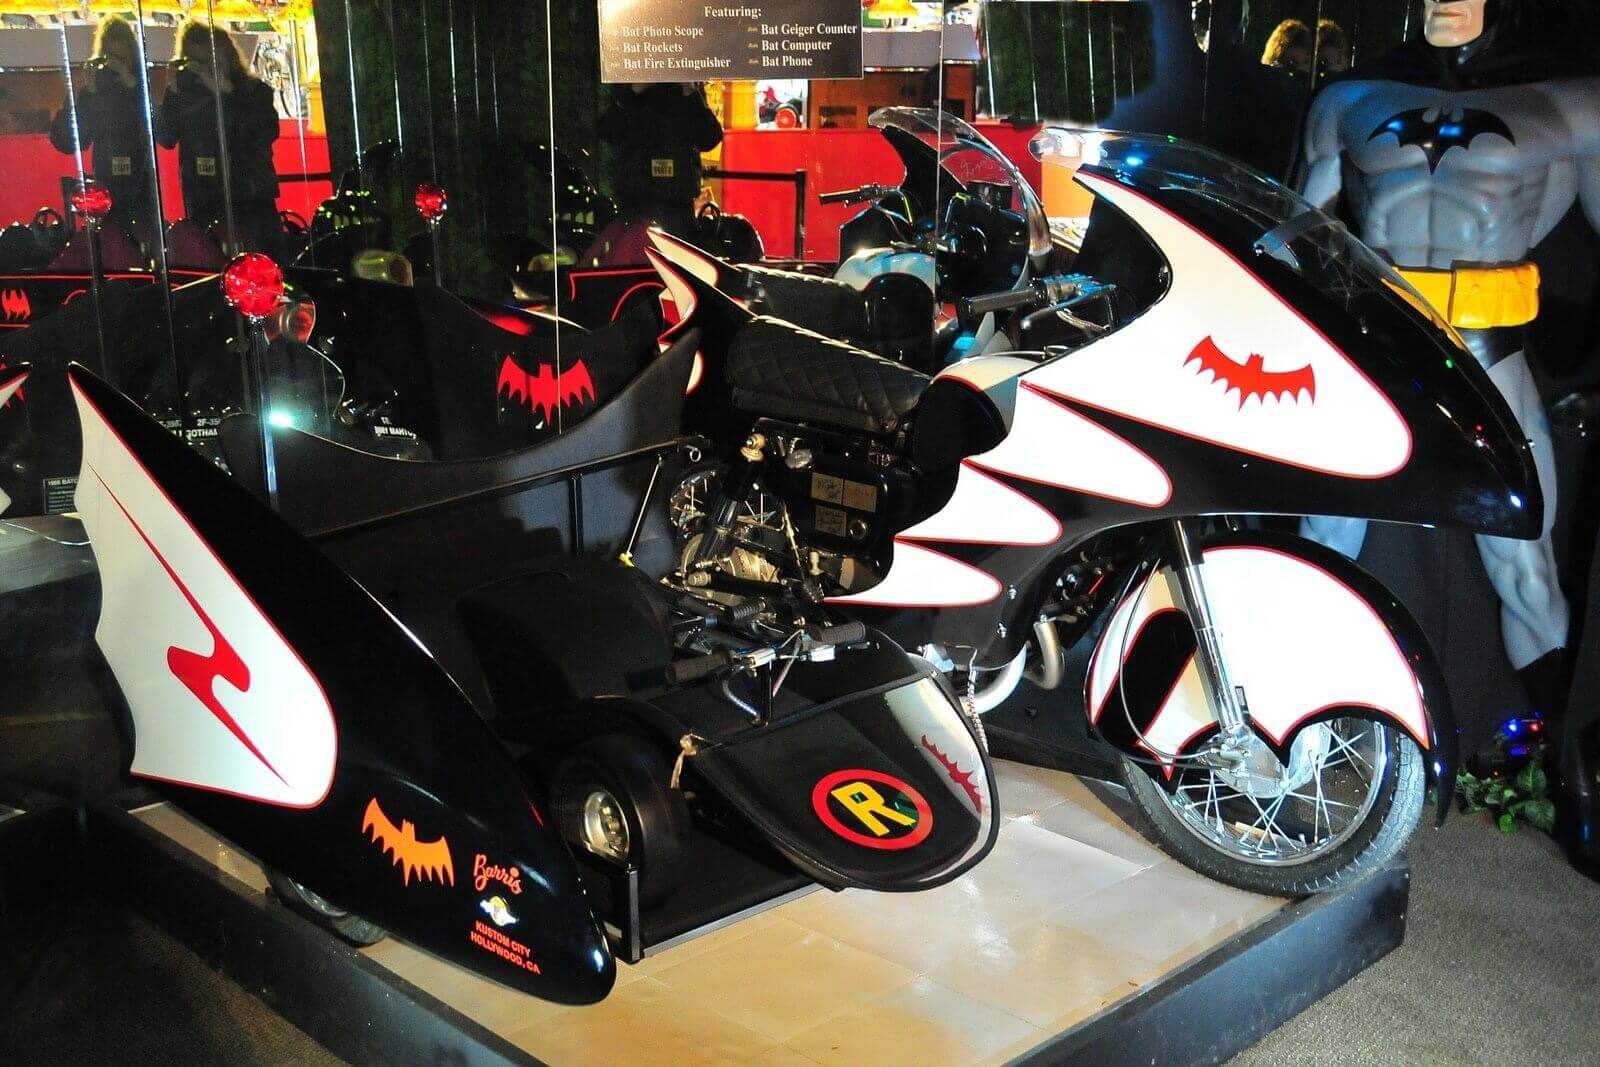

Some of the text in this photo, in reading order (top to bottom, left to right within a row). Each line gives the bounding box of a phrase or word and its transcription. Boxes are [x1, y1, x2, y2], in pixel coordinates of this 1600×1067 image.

[704, 5, 762, 19] Featuring:
[622, 25, 704, 39] Bat Photo Scope
[761, 23, 858, 37] Bat Geiger Counter
[623, 41, 683, 53] Bat Rockets
[761, 39, 832, 53] Bat Computer
[624, 56, 732, 70] Bat Fire Extinguisher
[762, 55, 813, 67] Bat Phone
[831, 781, 917, 837] R
[473, 853, 522, 895] Barris
[475, 920, 531, 958] KUSTOM CITY
